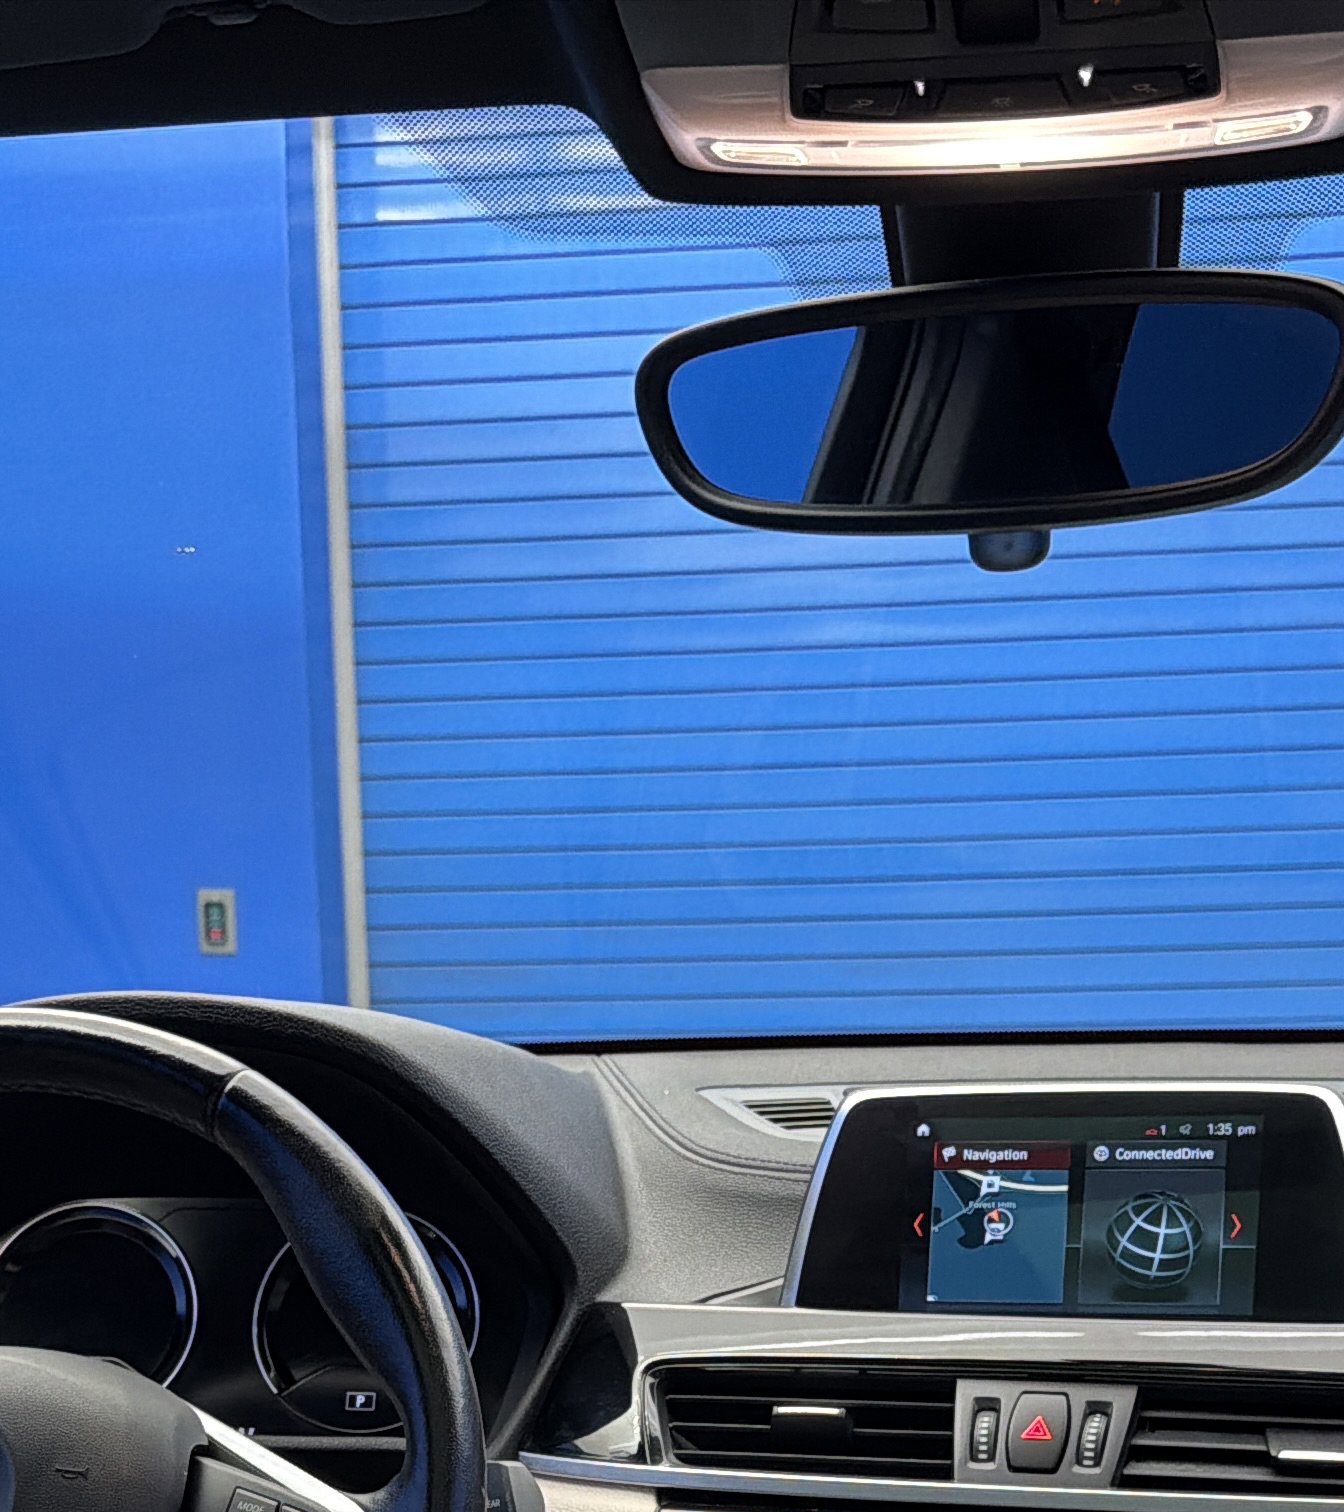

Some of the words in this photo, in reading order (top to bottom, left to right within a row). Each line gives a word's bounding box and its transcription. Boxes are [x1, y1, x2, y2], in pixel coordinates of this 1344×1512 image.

[1206, 1122, 1233, 1137] 1:35
[1237, 1124, 1257, 1139] pm
[962, 1147, 1030, 1164] Navigation
[1114, 1146, 1215, 1162] ConnectedDrive
[355, 1394, 366, 1408] P
